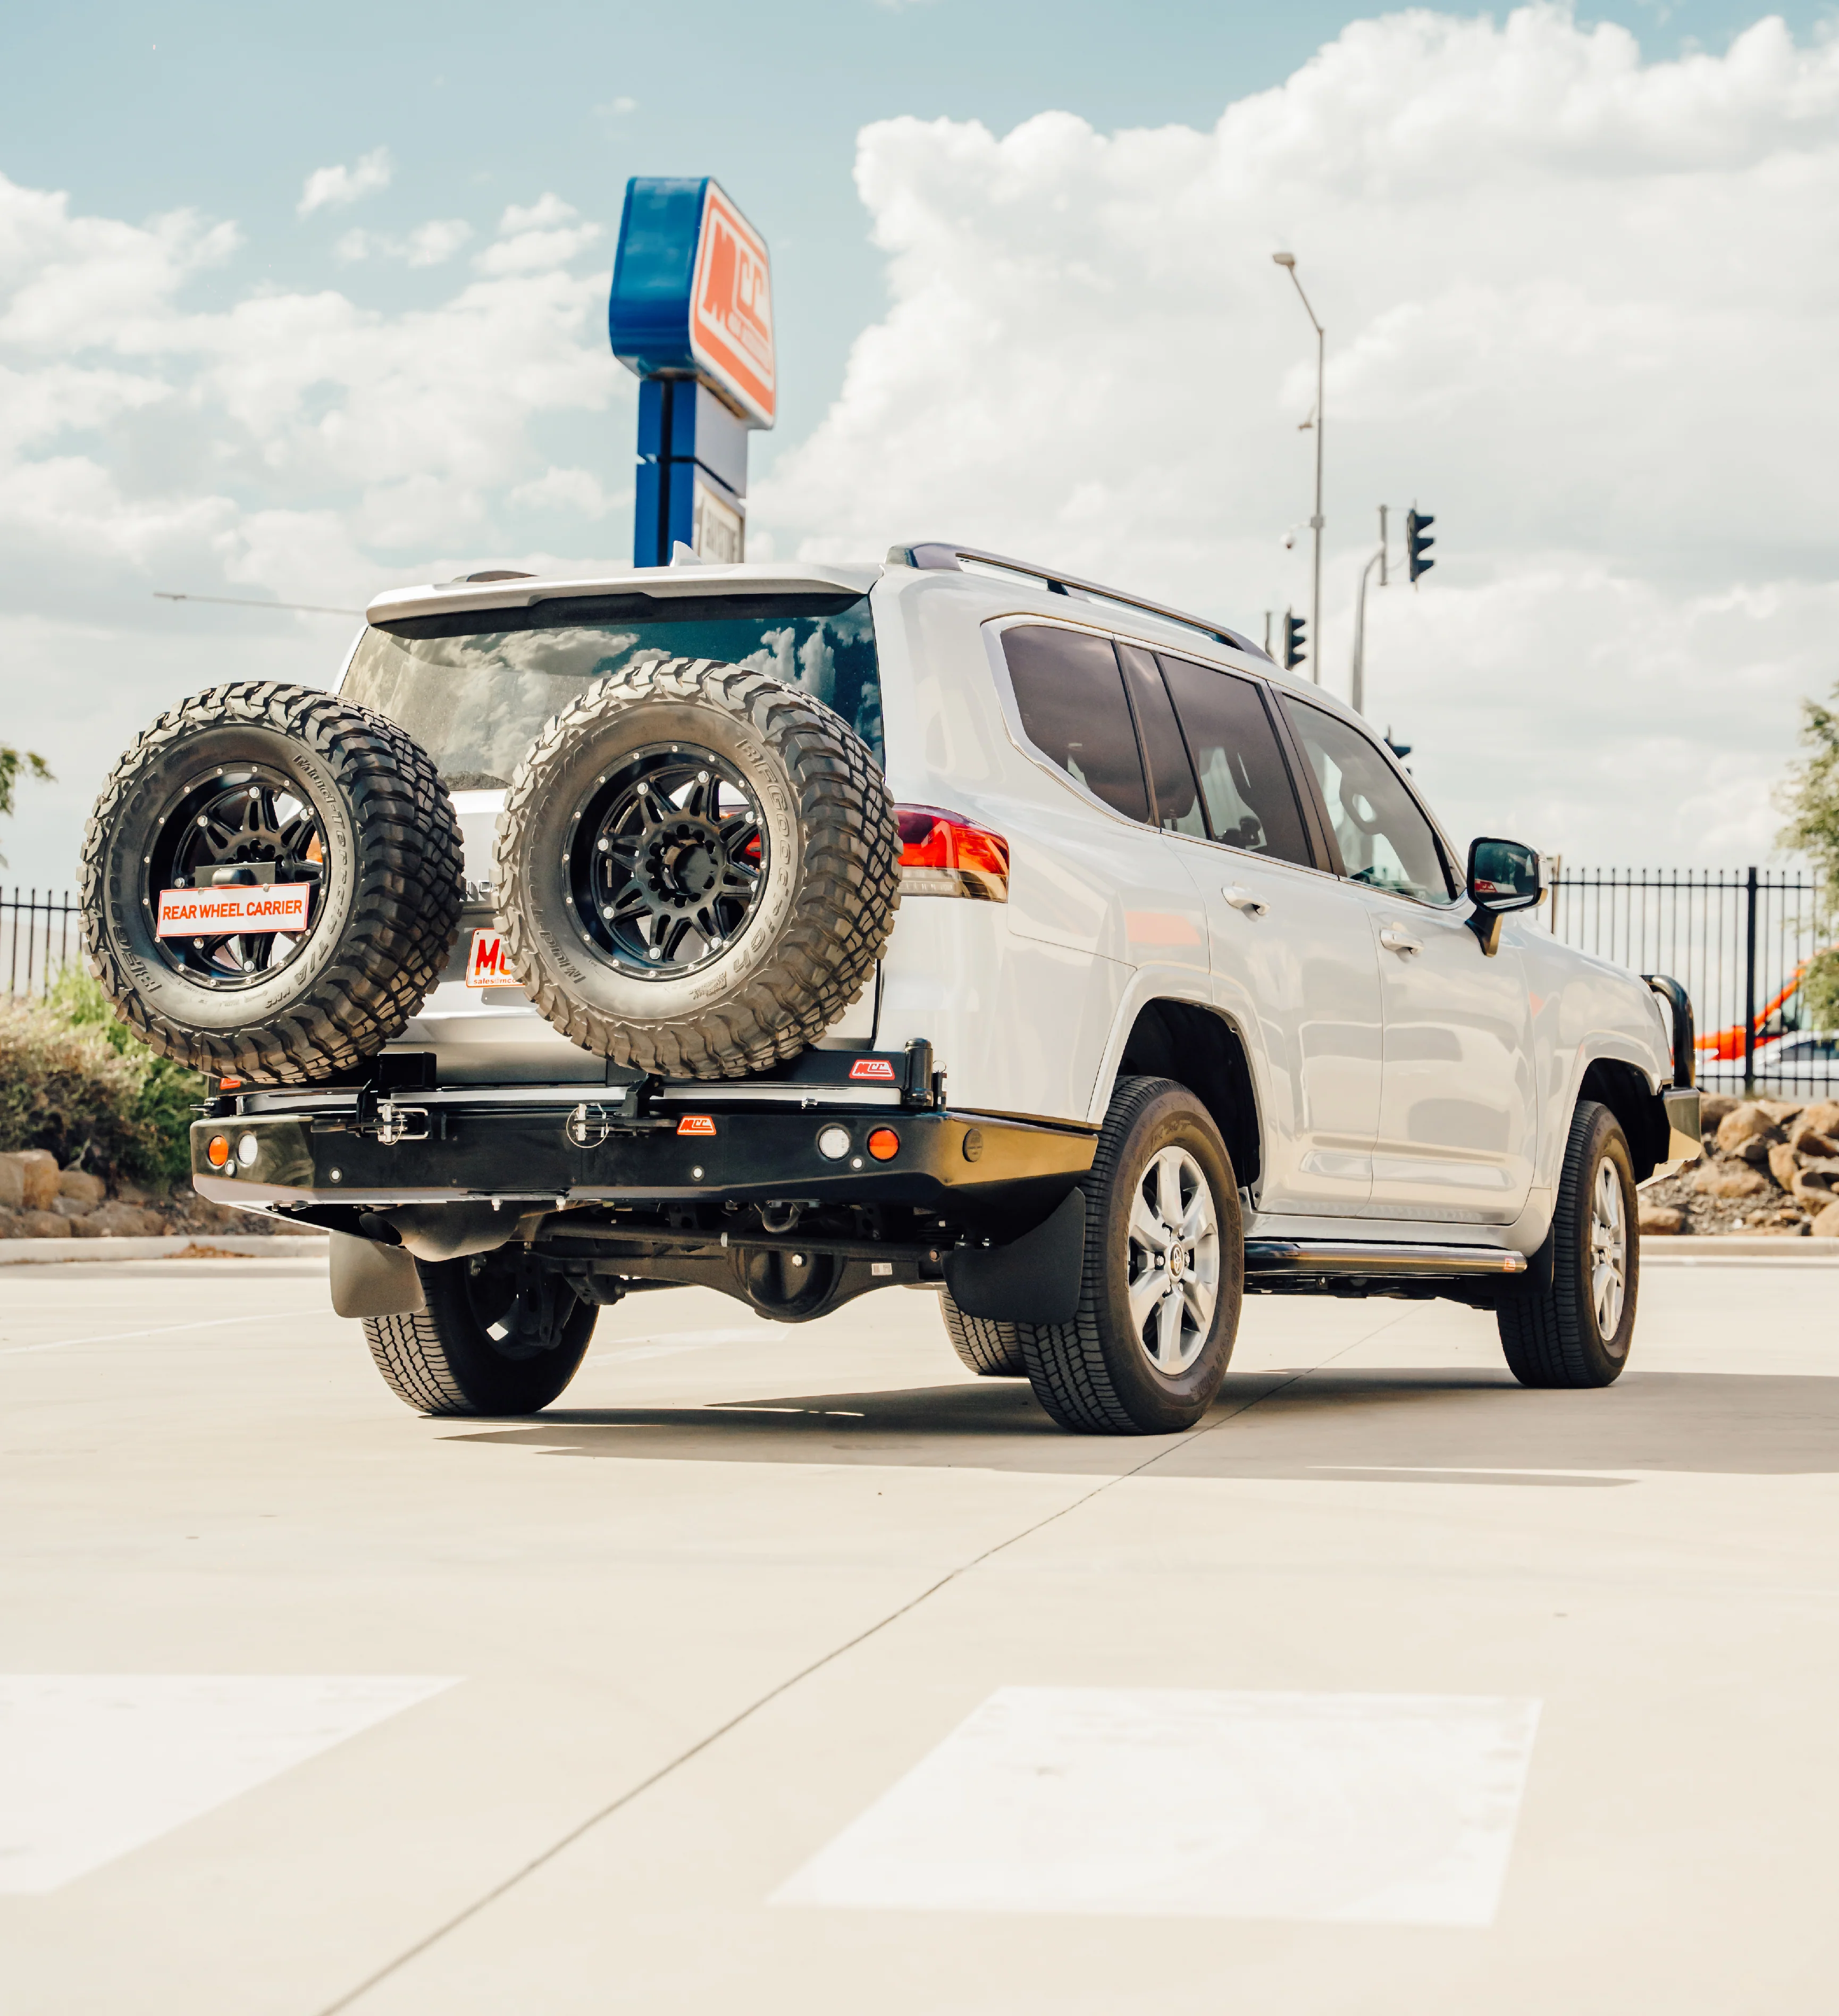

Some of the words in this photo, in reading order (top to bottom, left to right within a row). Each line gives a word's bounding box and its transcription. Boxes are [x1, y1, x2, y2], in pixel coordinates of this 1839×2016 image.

[163, 905, 197, 920] REAR
[199, 903, 244, 918] WHEEL
[246, 900, 302, 916] CARRIER
[854, 1063, 891, 1074] MCC
[680, 1119, 713, 1131] MCC
